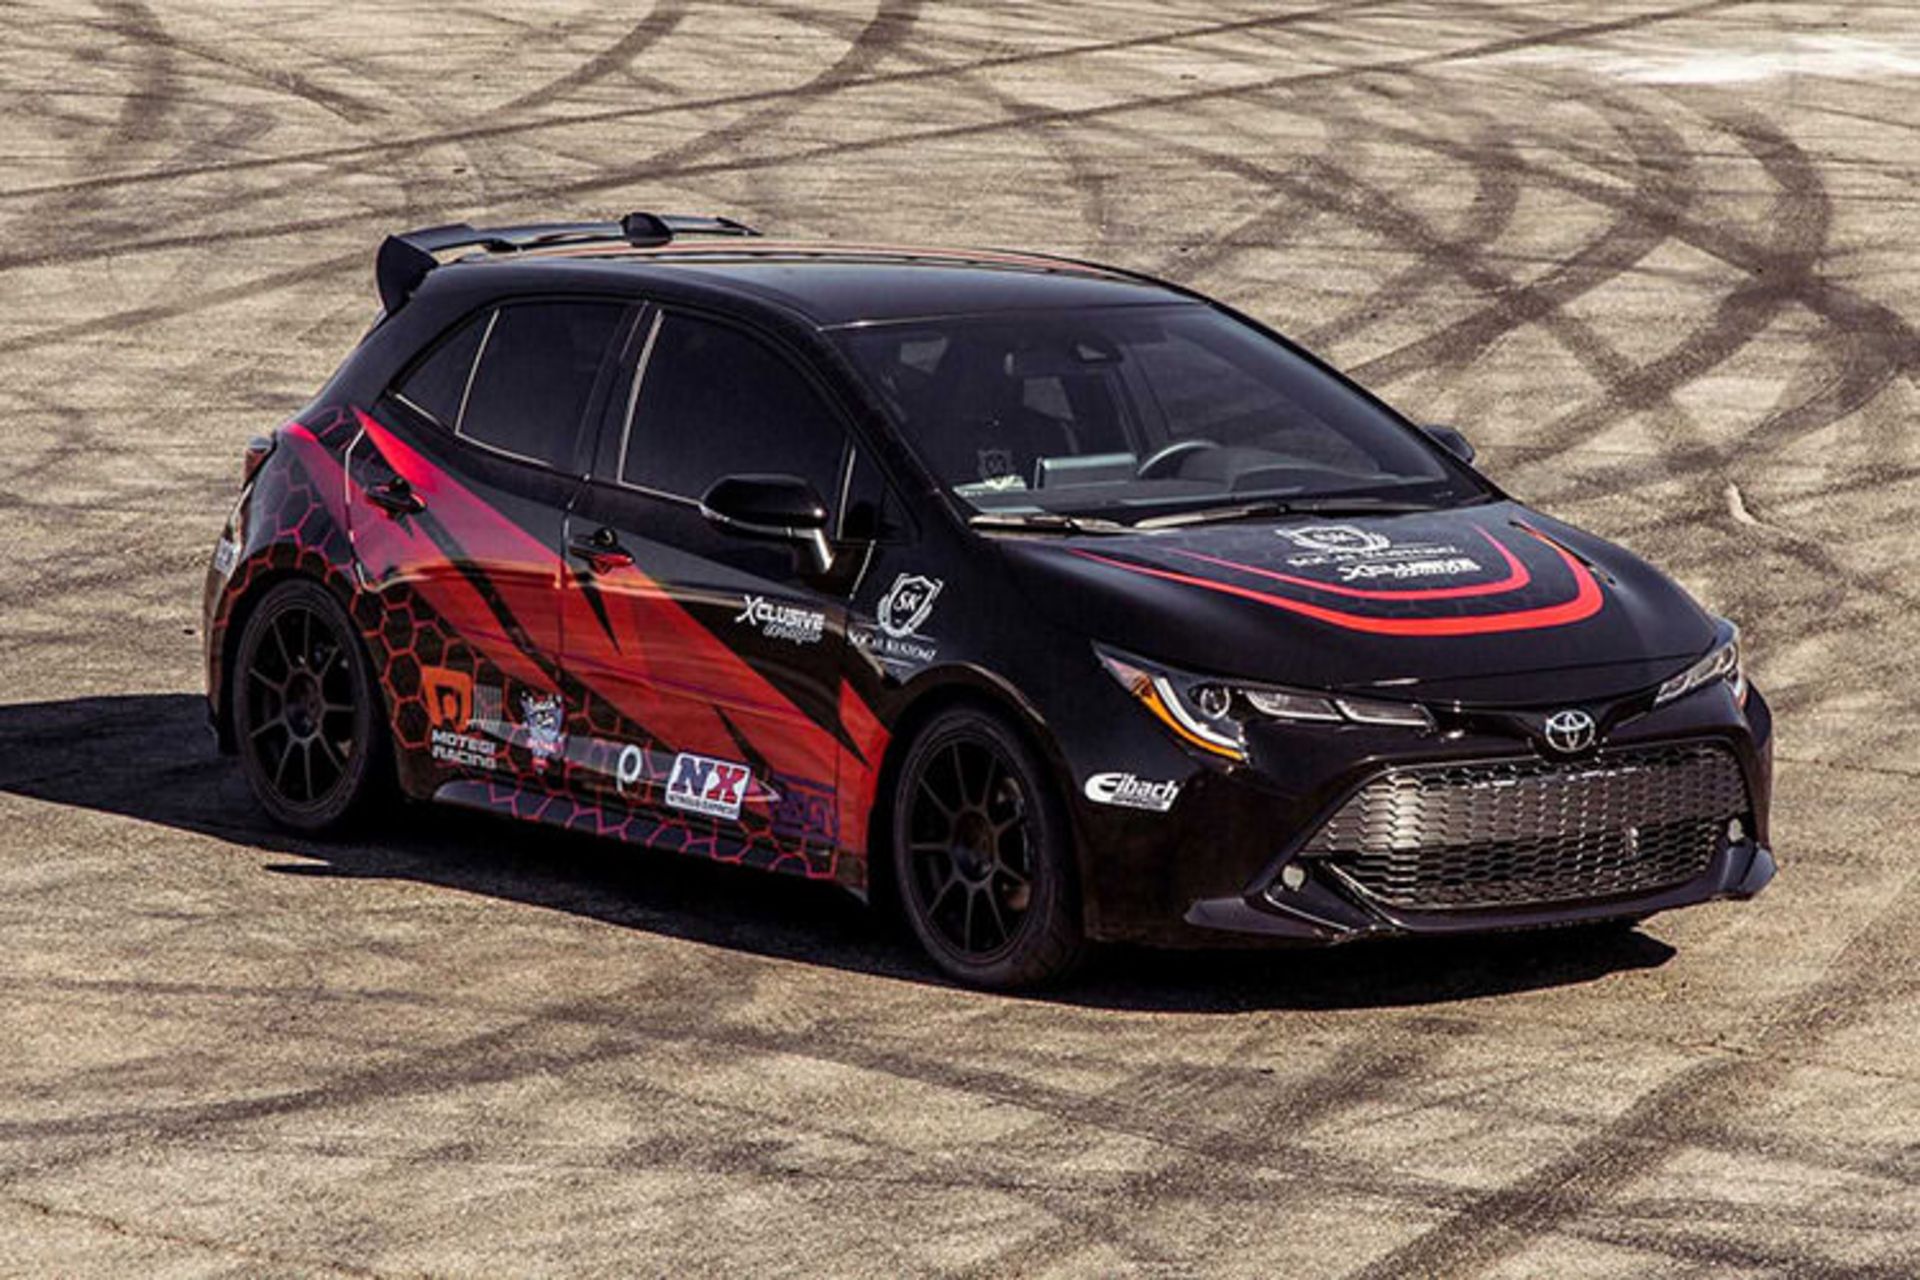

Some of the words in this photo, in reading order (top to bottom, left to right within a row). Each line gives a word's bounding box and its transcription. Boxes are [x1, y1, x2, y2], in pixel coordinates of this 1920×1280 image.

[735, 594, 825, 632] XCLUSIVE
[893, 590, 923, 611] SK
[432, 729, 496, 755] MOTEGI
[432, 745, 497, 769] RACING
[670, 756, 746, 804] NX
[1084, 771, 1179, 812] Eibach
